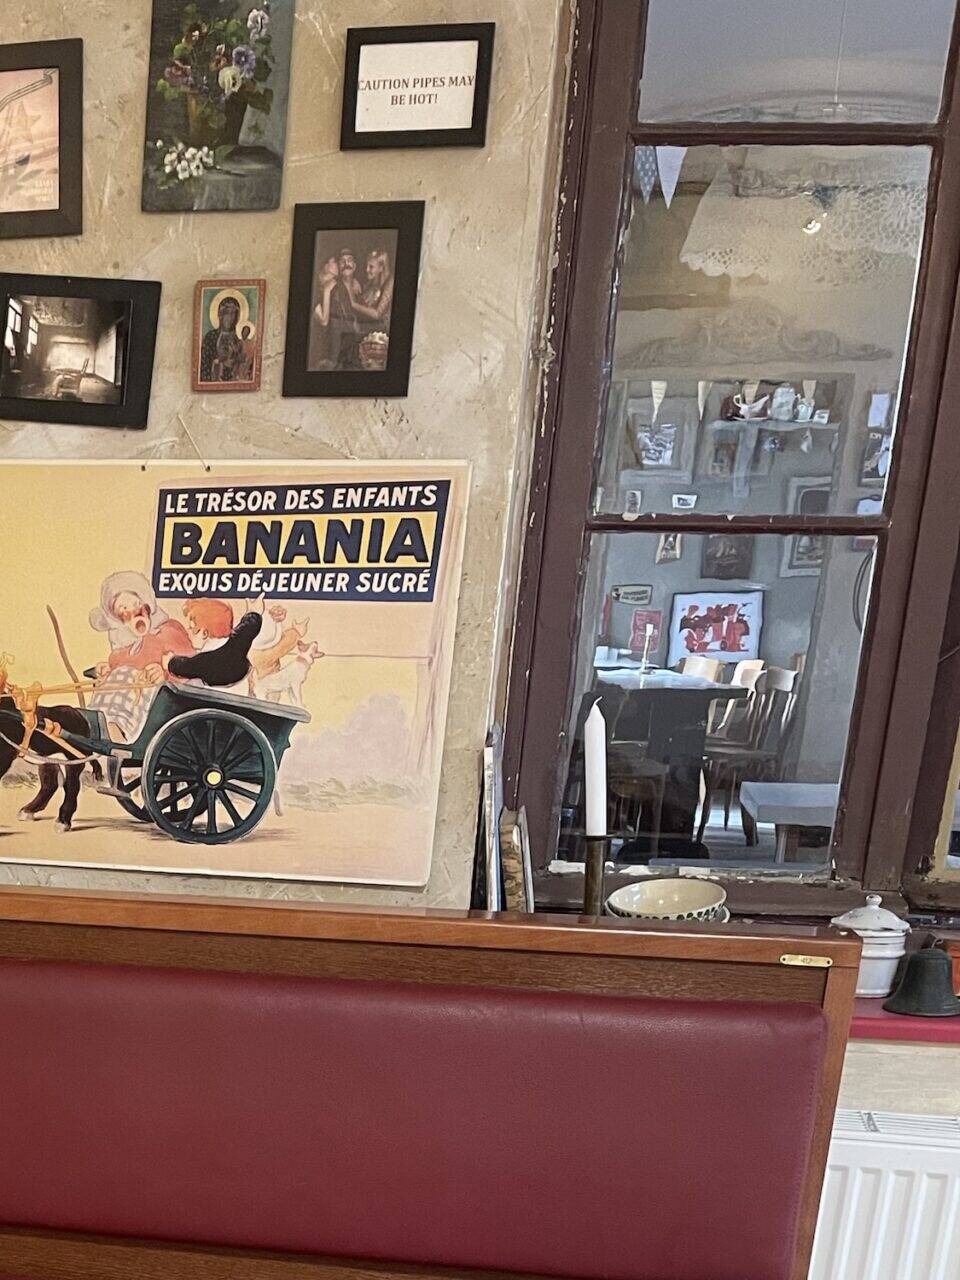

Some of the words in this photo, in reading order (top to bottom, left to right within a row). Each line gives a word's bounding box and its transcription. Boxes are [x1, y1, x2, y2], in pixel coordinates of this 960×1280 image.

[358, 77, 410, 91] CAUTION
[412, 76, 445, 88] PIPES
[448, 75, 475, 87] MAY
[391, 94, 406, 106] BE
[409, 93, 438, 105] HOT!
[165, 493, 189, 514] LE
[195, 489, 278, 513] TRÉSOR
[285, 488, 325, 511] DES
[332, 485, 438, 509] ENFANTS
[169, 518, 430, 566] BANANIA
[159, 572, 233, 595] EXQUIS
[237, 569, 350, 594] DÉJEUNER
[356, 568, 432, 593] SUCRÉ
